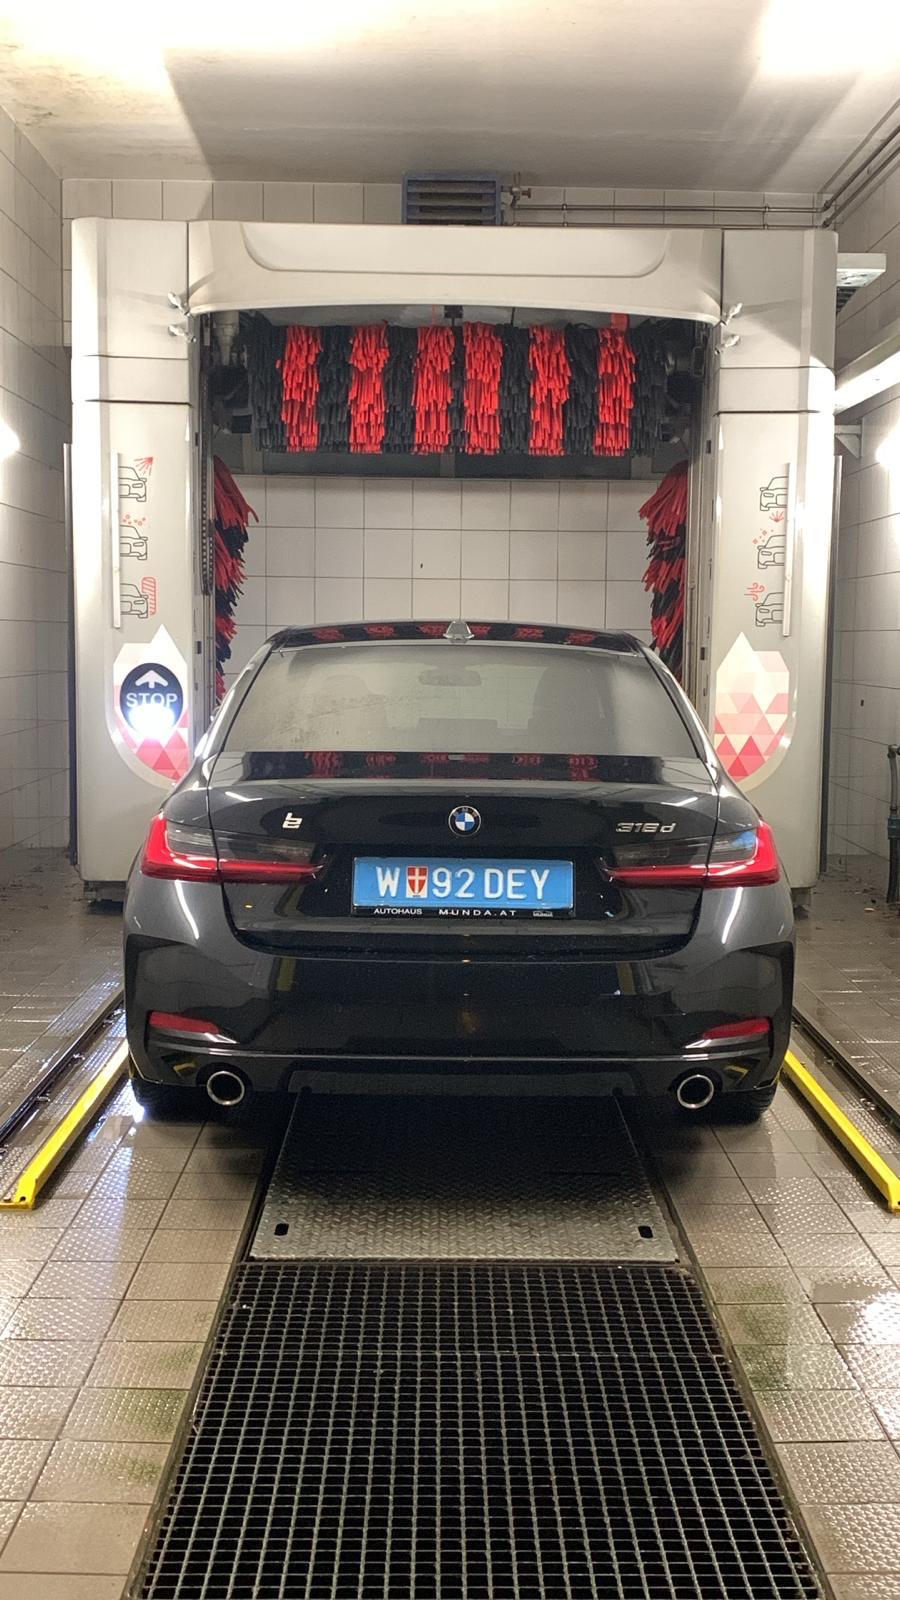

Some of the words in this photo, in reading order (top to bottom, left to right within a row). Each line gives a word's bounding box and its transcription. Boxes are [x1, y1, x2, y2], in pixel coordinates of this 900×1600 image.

[126, 692, 178, 708] STOP
[615, 822, 677, 833] 318d
[375, 866, 401, 898] W
[432, 867, 475, 899] 92
[484, 868, 550, 900] DEY
[373, 907, 423, 916] AUTOHAUS
[438, 909, 518, 917] MUNDA.AT
